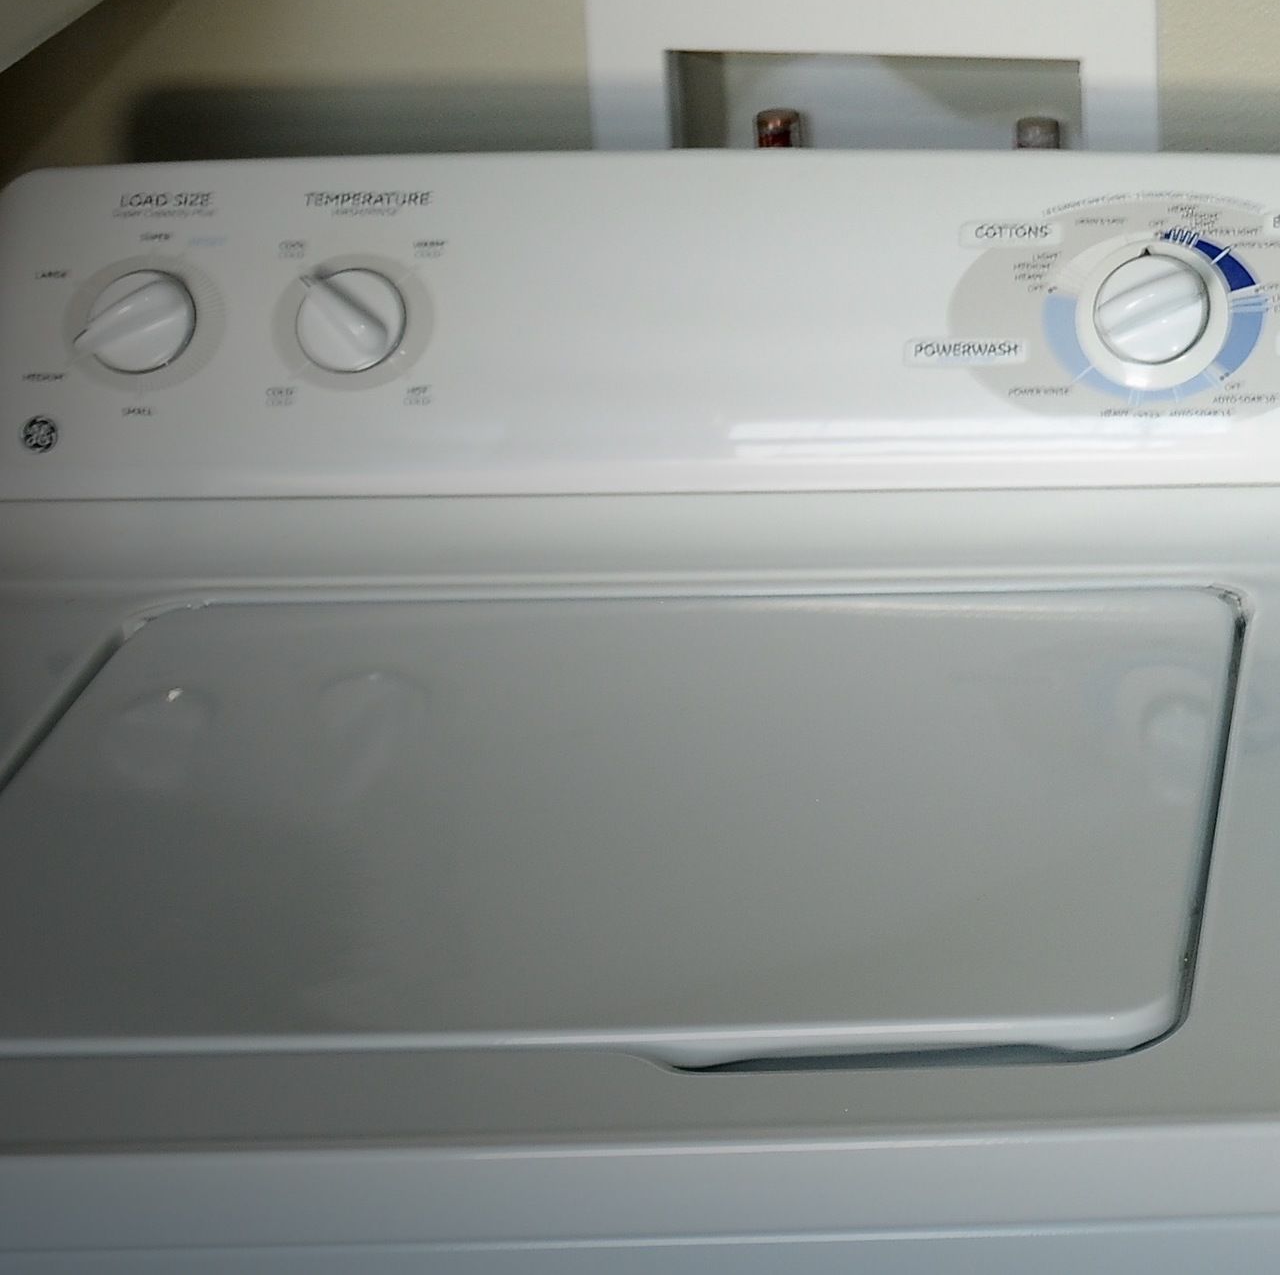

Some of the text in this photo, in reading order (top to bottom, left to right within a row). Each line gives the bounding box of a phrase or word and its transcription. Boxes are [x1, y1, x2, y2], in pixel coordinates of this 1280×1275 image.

[120, 192, 216, 208] LOAD SIZE
[304, 191, 433, 207] TEMPERATURE
[975, 224, 1053, 239] COTTONS
[914, 340, 1021, 358] POWERWASH
